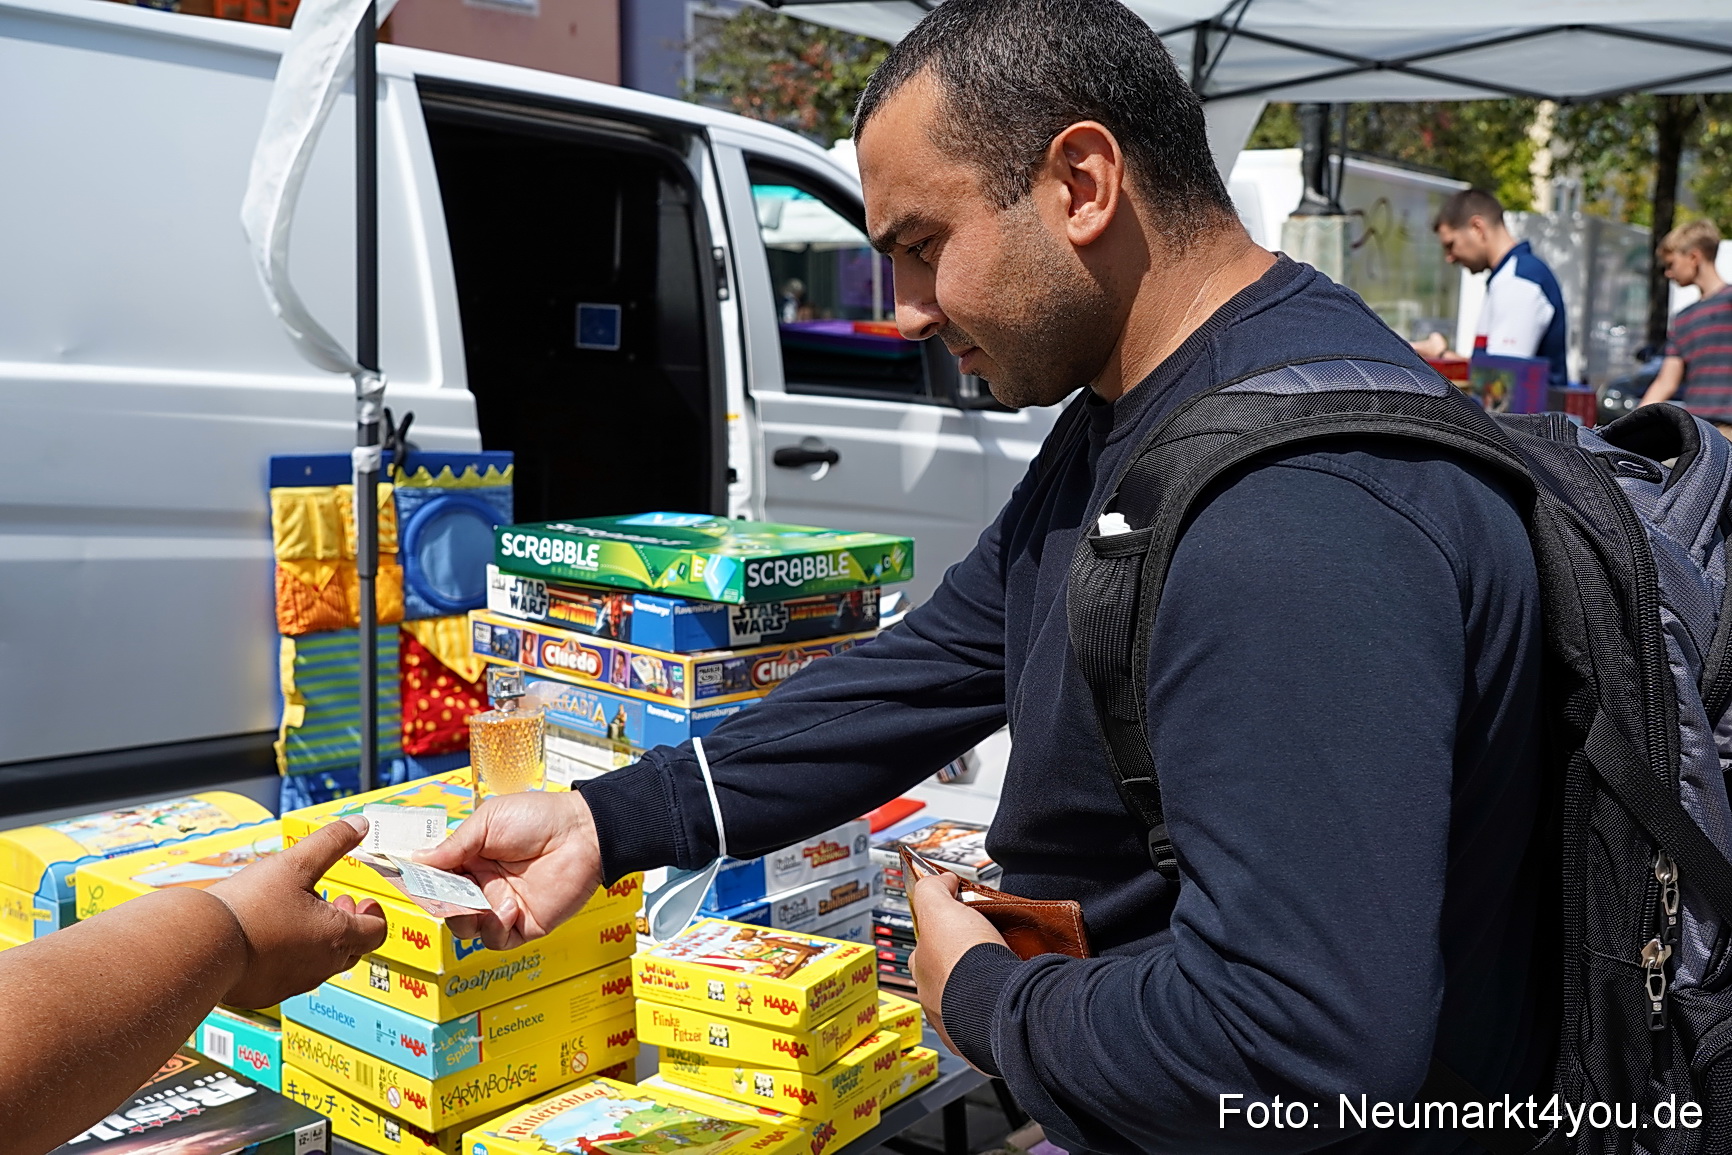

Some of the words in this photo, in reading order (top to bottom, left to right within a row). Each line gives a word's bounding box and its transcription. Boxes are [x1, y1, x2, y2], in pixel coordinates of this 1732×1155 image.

[501, 532, 600, 566] SCRABBLE
[747, 552, 850, 587] SCRABBLE
[510, 578, 547, 598] STAR
[510, 594, 547, 615] WARS
[674, 600, 725, 615] Ravensburger
[732, 602, 787, 620] STAR
[733, 616, 788, 636] WARS
[544, 644, 598, 674] Cluedo
[756, 655, 813, 682] Clued
[691, 705, 740, 721] Ravensburger
[607, 877, 638, 898] HABA
[402, 926, 431, 949] HABA
[600, 923, 631, 944] HABA
[399, 973, 428, 998] HABA
[445, 953, 541, 997] Coolympics
[602, 975, 632, 996] HABA
[851, 964, 873, 986] HABA
[309, 994, 355, 1028] Lesehexe
[763, 995, 799, 1015] HABA
[857, 1004, 877, 1027] HABA
[489, 1012, 544, 1040] Lesehexe
[653, 1011, 680, 1027] Flinke
[896, 1016, 916, 1029] HABA
[401, 1033, 427, 1057] HABA
[607, 1028, 636, 1048] HABA
[772, 1038, 809, 1059] HABA
[238, 1045, 270, 1070] HABA
[446, 1040, 474, 1065] Spiel
[874, 1050, 897, 1073] HABA
[918, 1062, 935, 1079] HABA
[404, 1087, 427, 1110] HABA
[783, 1084, 818, 1106] HABA
[506, 1088, 608, 1137] Ritterschlag
[853, 1096, 877, 1120] HABA
[751, 1129, 788, 1150] HABA
